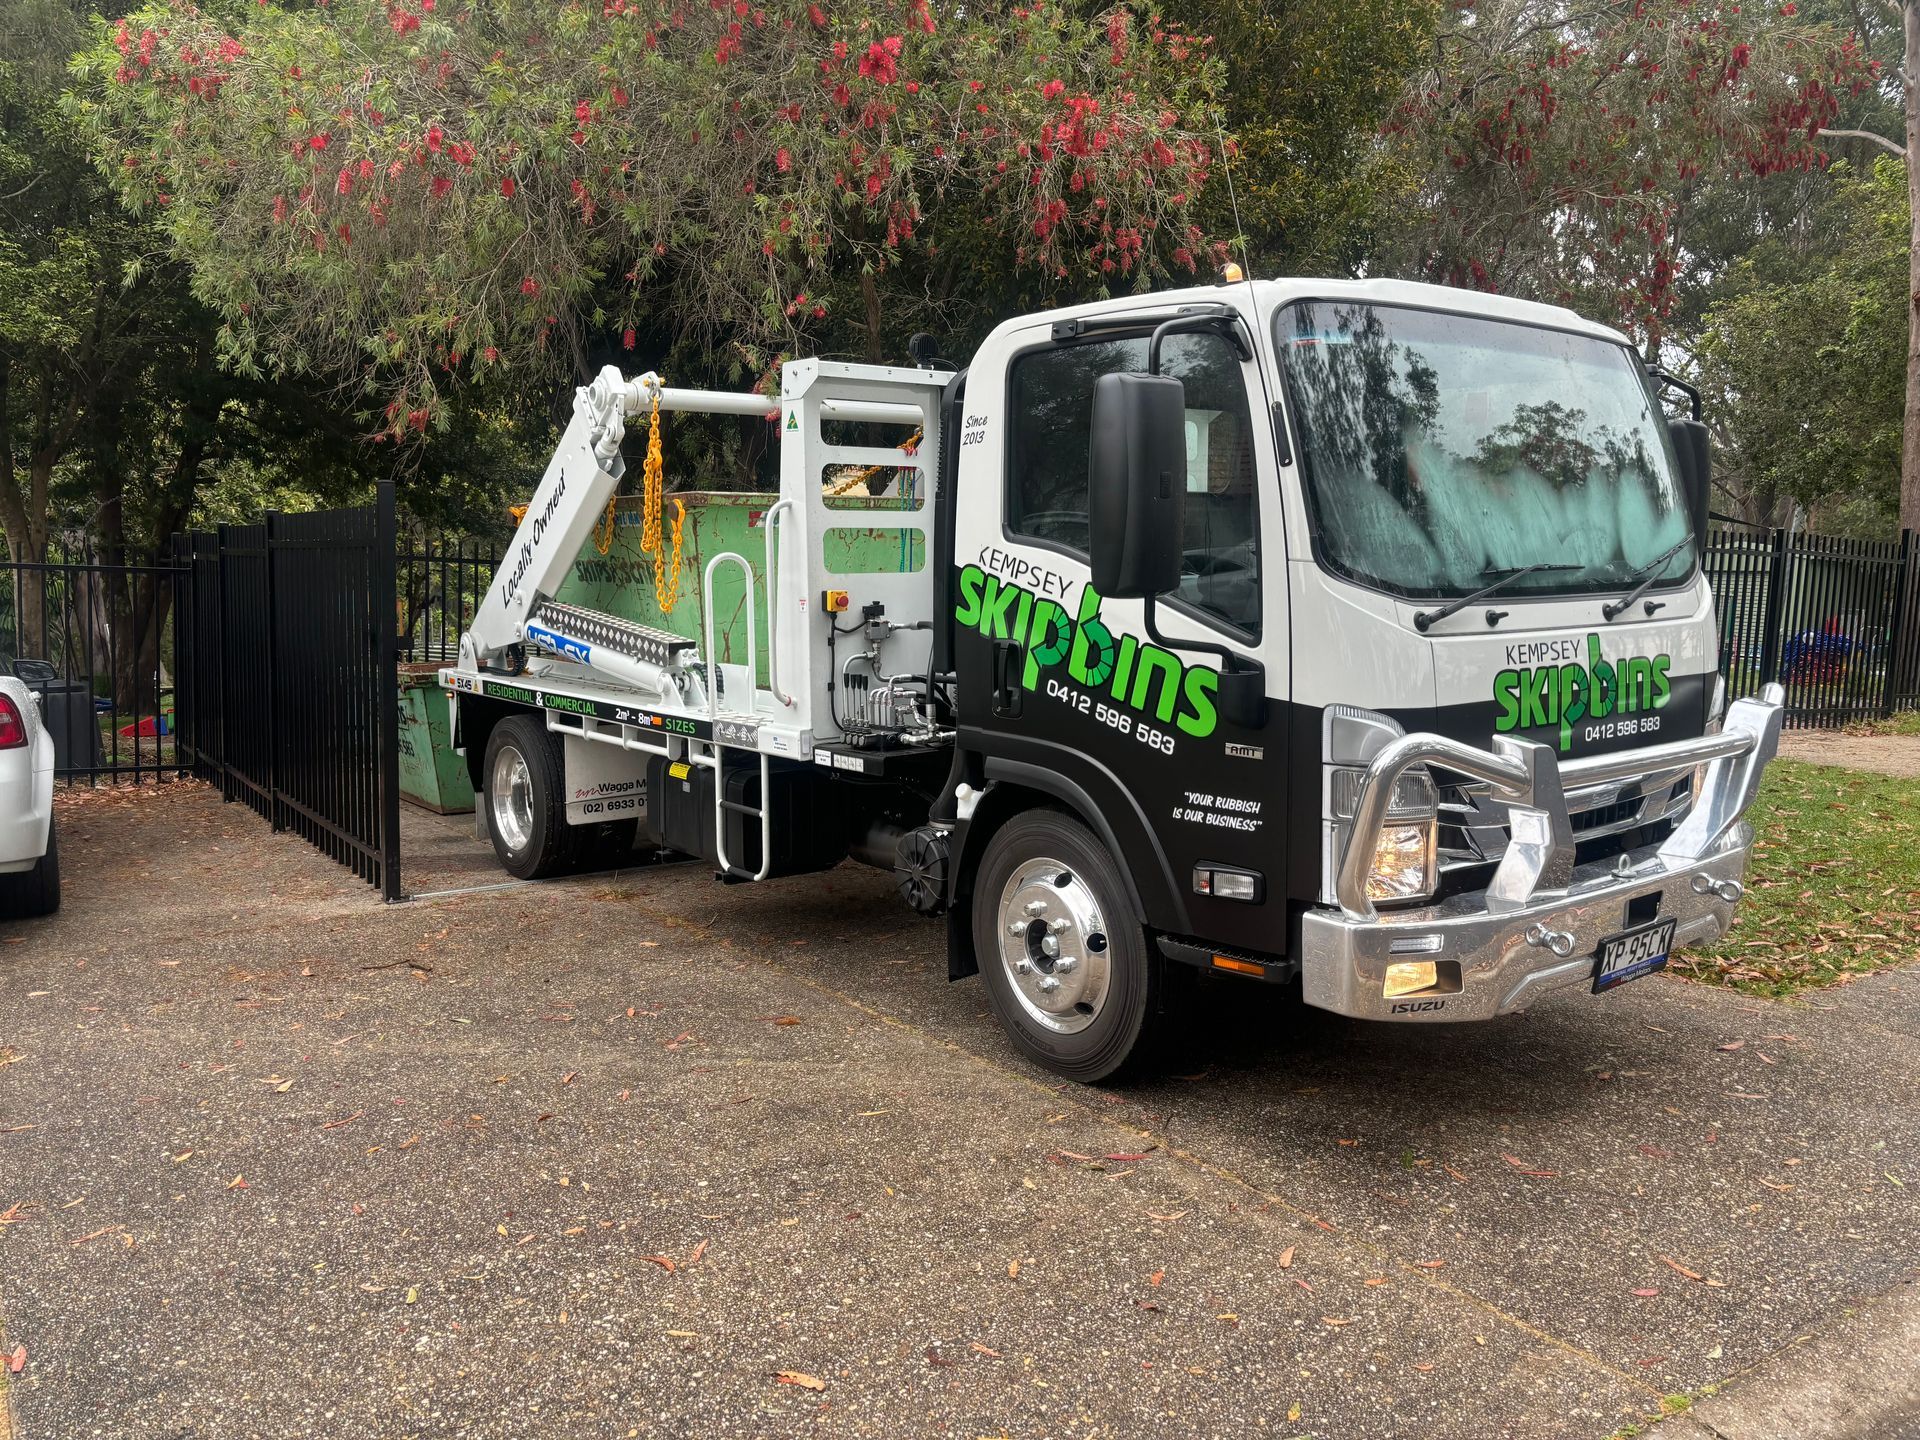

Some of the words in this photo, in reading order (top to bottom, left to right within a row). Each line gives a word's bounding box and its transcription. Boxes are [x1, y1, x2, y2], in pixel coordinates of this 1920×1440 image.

[965, 415, 988, 429] Since
[962, 430, 985, 446] 2013
[502, 539, 533, 609] Locally
[533, 467, 566, 546] Owned
[978, 545, 1074, 600] KEMPSEY
[1506, 639, 1580, 665] KEMPSEY
[487, 683, 535, 704] RESIDENTIAL
[535, 691, 544, 707] &
[545, 694, 598, 716] COMMERCIAL
[1046, 679, 1091, 715] 0412
[1095, 703, 1132, 734] 596
[1136, 723, 1175, 756] 583
[665, 718, 696, 734] SIZES
[1585, 722, 1614, 742] 0412
[1617, 720, 1638, 736] 596
[1640, 716, 1661, 731] 583
[1230, 745, 1257, 757] AMT
[598, 780, 634, 793] Wagga
[583, 802, 604, 815] (02)
[607, 799, 635, 811] 6933
[1215, 796, 1261, 814] RUBBISH
[1172, 807, 1183, 819] IS
[1184, 809, 1205, 823] OUR
[1391, 1000, 1446, 1014] ISUZU
